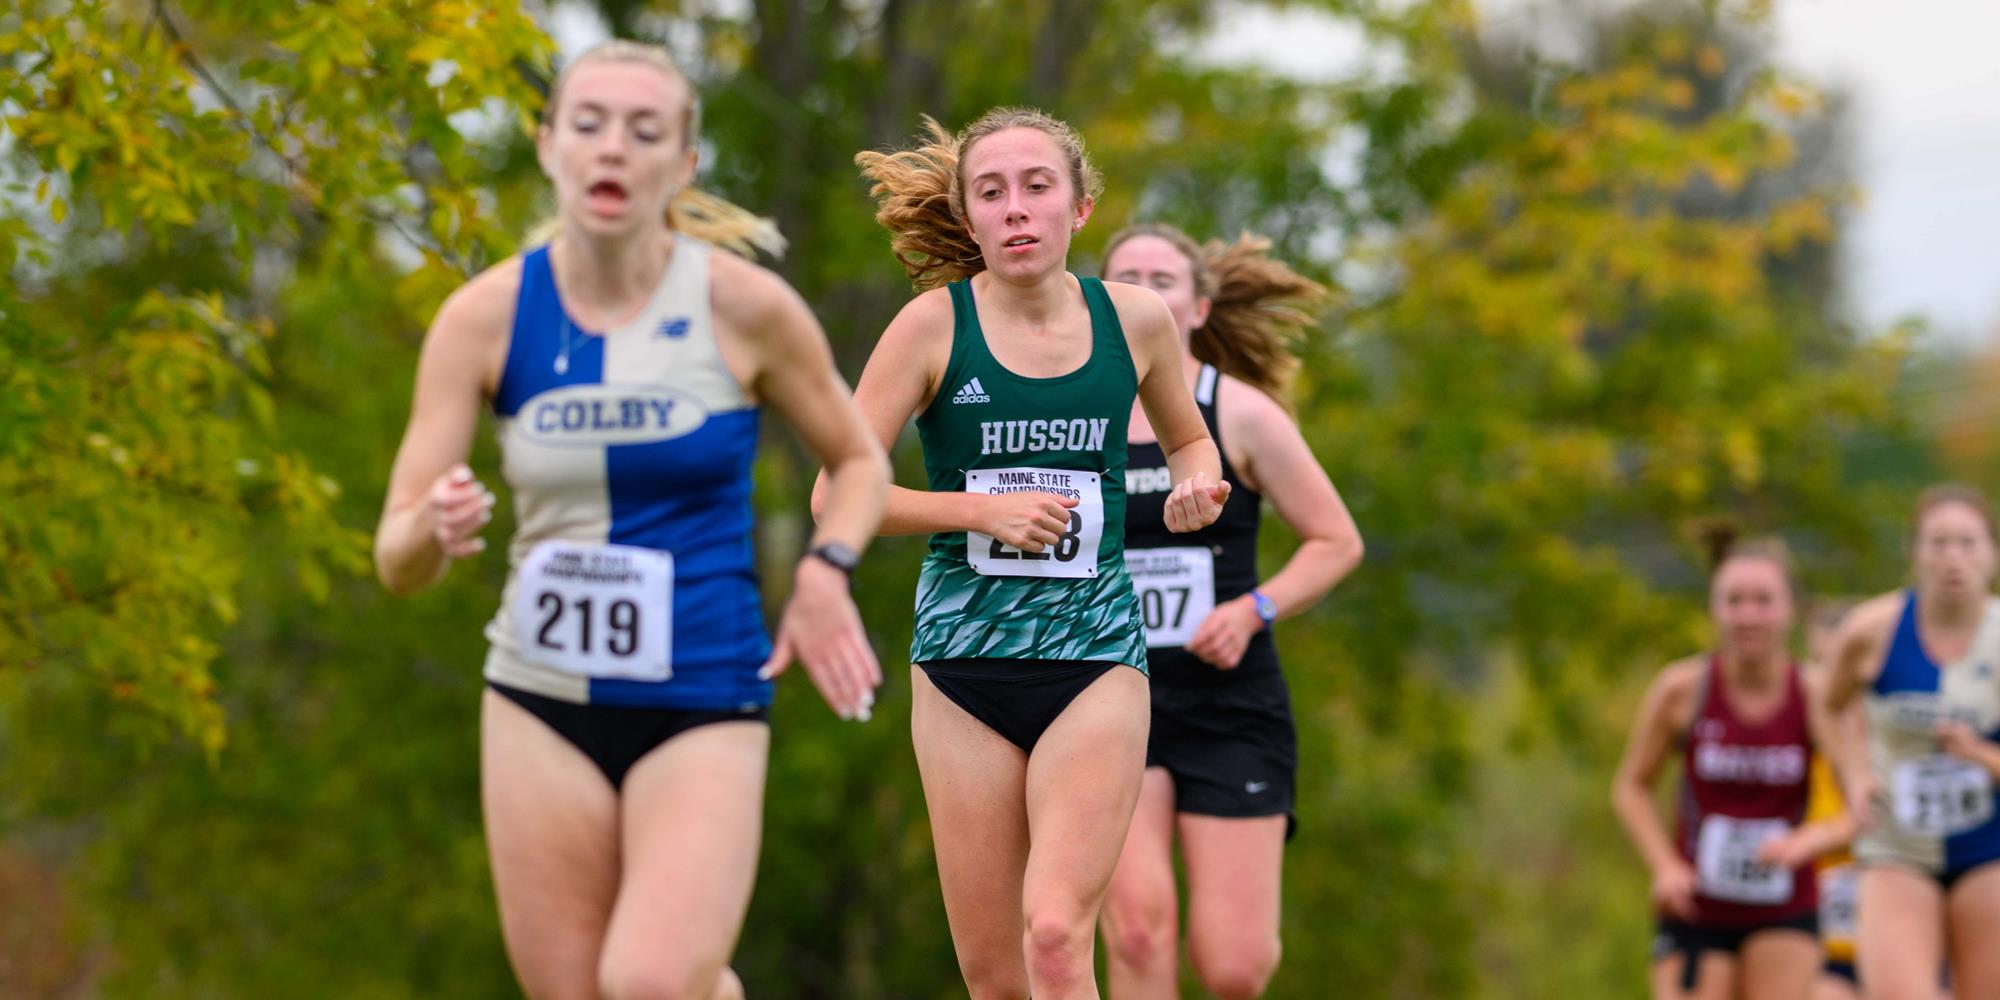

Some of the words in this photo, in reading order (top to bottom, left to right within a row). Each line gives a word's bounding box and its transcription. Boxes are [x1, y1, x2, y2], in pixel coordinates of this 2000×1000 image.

[535, 397, 675, 433] COLBY
[953, 393, 990, 405] adidas
[981, 418, 1110, 455] HUSSON
[998, 471, 1036, 486] MAINE
[1039, 472, 1072, 488] STATE
[537, 590, 639, 657] 219
